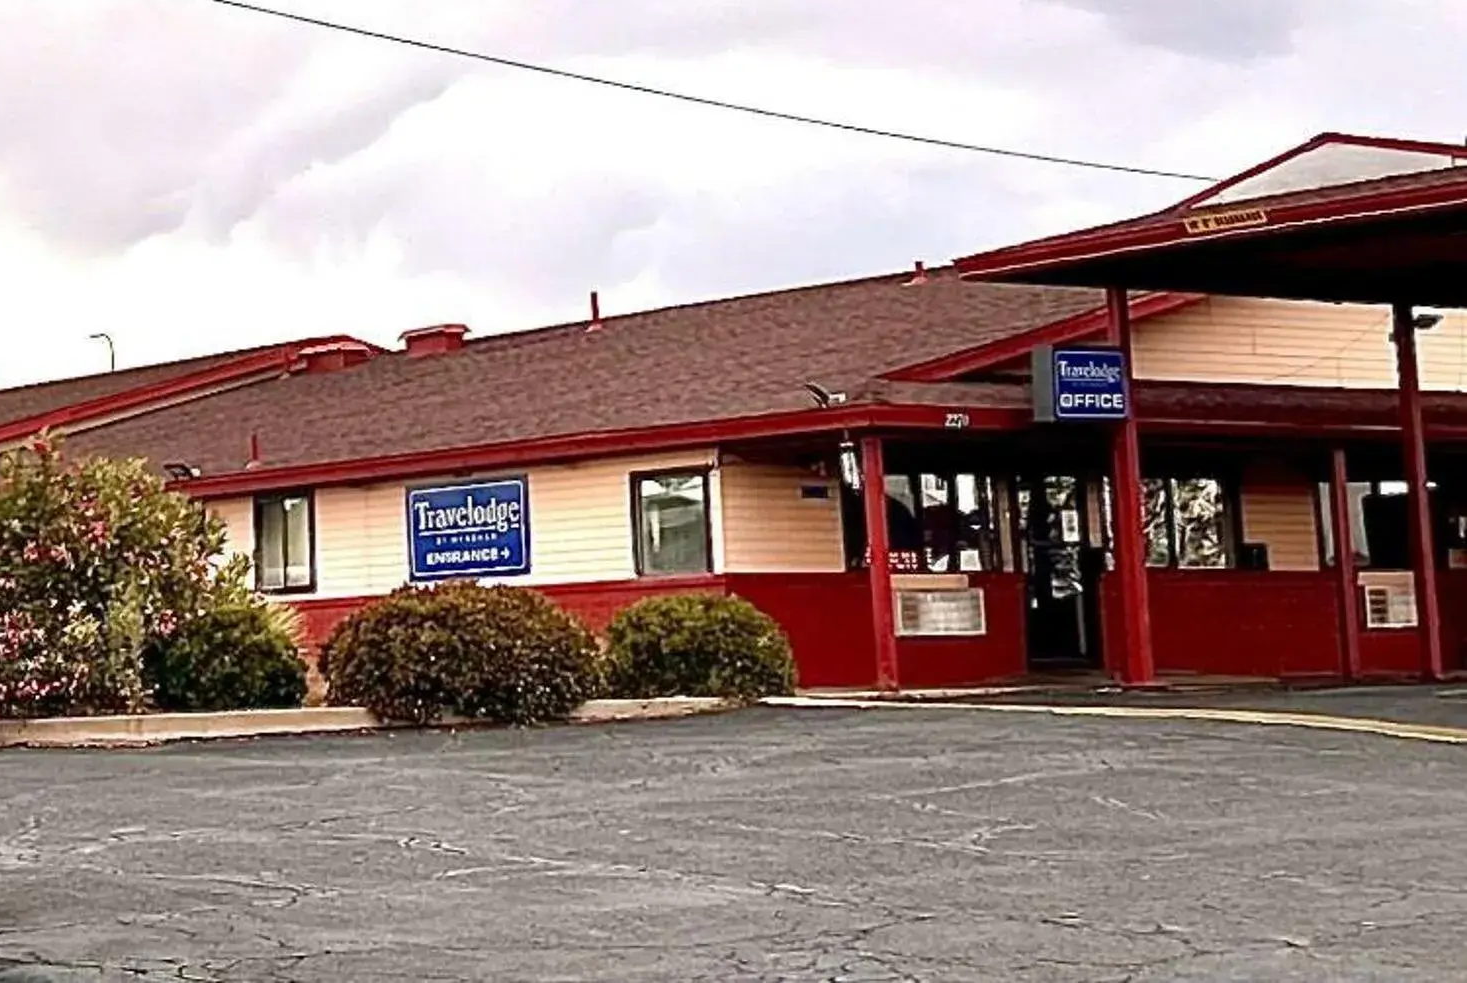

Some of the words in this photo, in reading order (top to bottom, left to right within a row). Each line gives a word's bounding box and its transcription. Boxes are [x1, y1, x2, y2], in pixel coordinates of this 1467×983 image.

[1058, 360, 1121, 383] Travelodge
[1059, 393, 1124, 409] OFFICE
[414, 495, 519, 532] Travelodge
[426, 547, 498, 565] ENTRANCE
